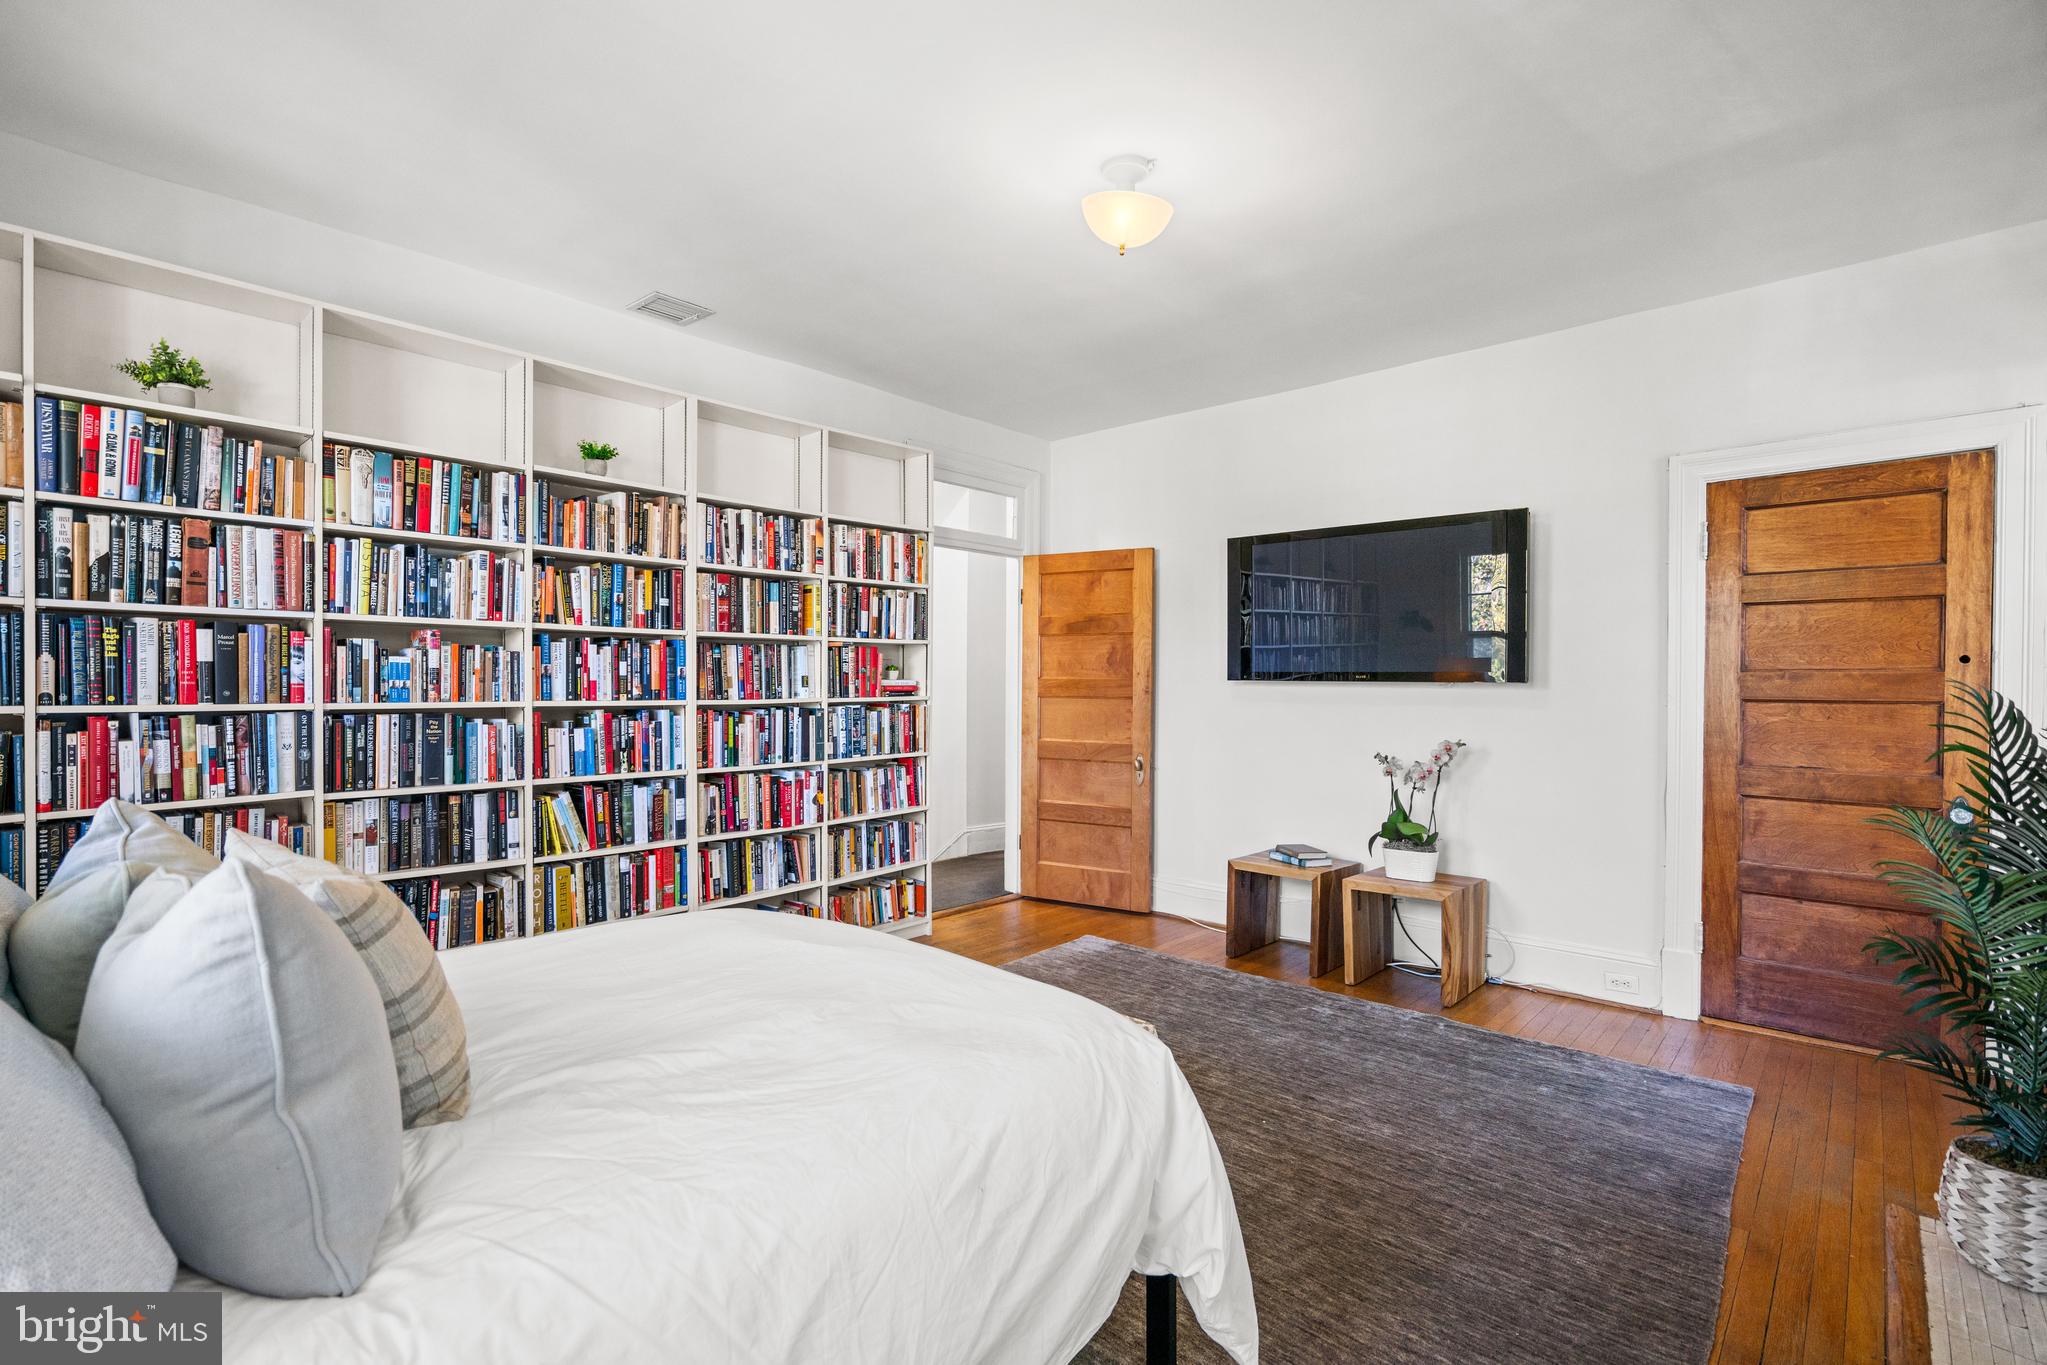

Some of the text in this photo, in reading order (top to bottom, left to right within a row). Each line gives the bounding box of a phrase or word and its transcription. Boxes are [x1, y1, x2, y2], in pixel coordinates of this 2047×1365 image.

[41, 401, 54, 454] DISNEYWAR
[84, 414, 95, 440] CRICHTON
[105, 433, 119, 453] CLOAK
[184, 440, 193, 449] AT
[104, 459, 117, 478] GOWN
[336, 447, 345, 467] SUEZ
[182, 480, 190, 498] EDGE
[236, 473, 244, 487] SPEED
[38, 519, 48, 533] DC
[151, 519, 164, 550] McGEORGE
[169, 524, 182, 558] LEGENDS
[38, 558, 46, 580] MEYER
[274, 533, 285, 599] DEVIL'S GAME
[305, 563, 313, 584] Richard
[361, 542, 372, 598] USAMA
[232, 577, 241, 600] LIAISON
[370, 581, 378, 606] MENGELE
[147, 623, 155, 646] ANDREI
[139, 622, 148, 690] SAKHAROV MEMOIRS
[163, 633, 172, 670] ALAN TURING
[73, 671, 86, 685] Cold
[226, 718, 235, 743] ELMORE
[301, 715, 308, 725] ON
[367, 740, 375, 758] NATURE
[227, 761, 236, 790] LEONARD
[68, 827, 76, 837] 109
[205, 815, 213, 828] THE
[391, 801, 399, 845] SECRET FATHER
[452, 804, 460, 845] TWILIGHT DESERT
[39, 829, 49, 853] DIANE
[50, 828, 61, 857] CARRY
[205, 829, 213, 842] END
[464, 827, 474, 851] Them
[421, 883, 429, 905] MARTIN
[533, 874, 542, 927] ROTH
[559, 882, 568, 915] BEETLE
